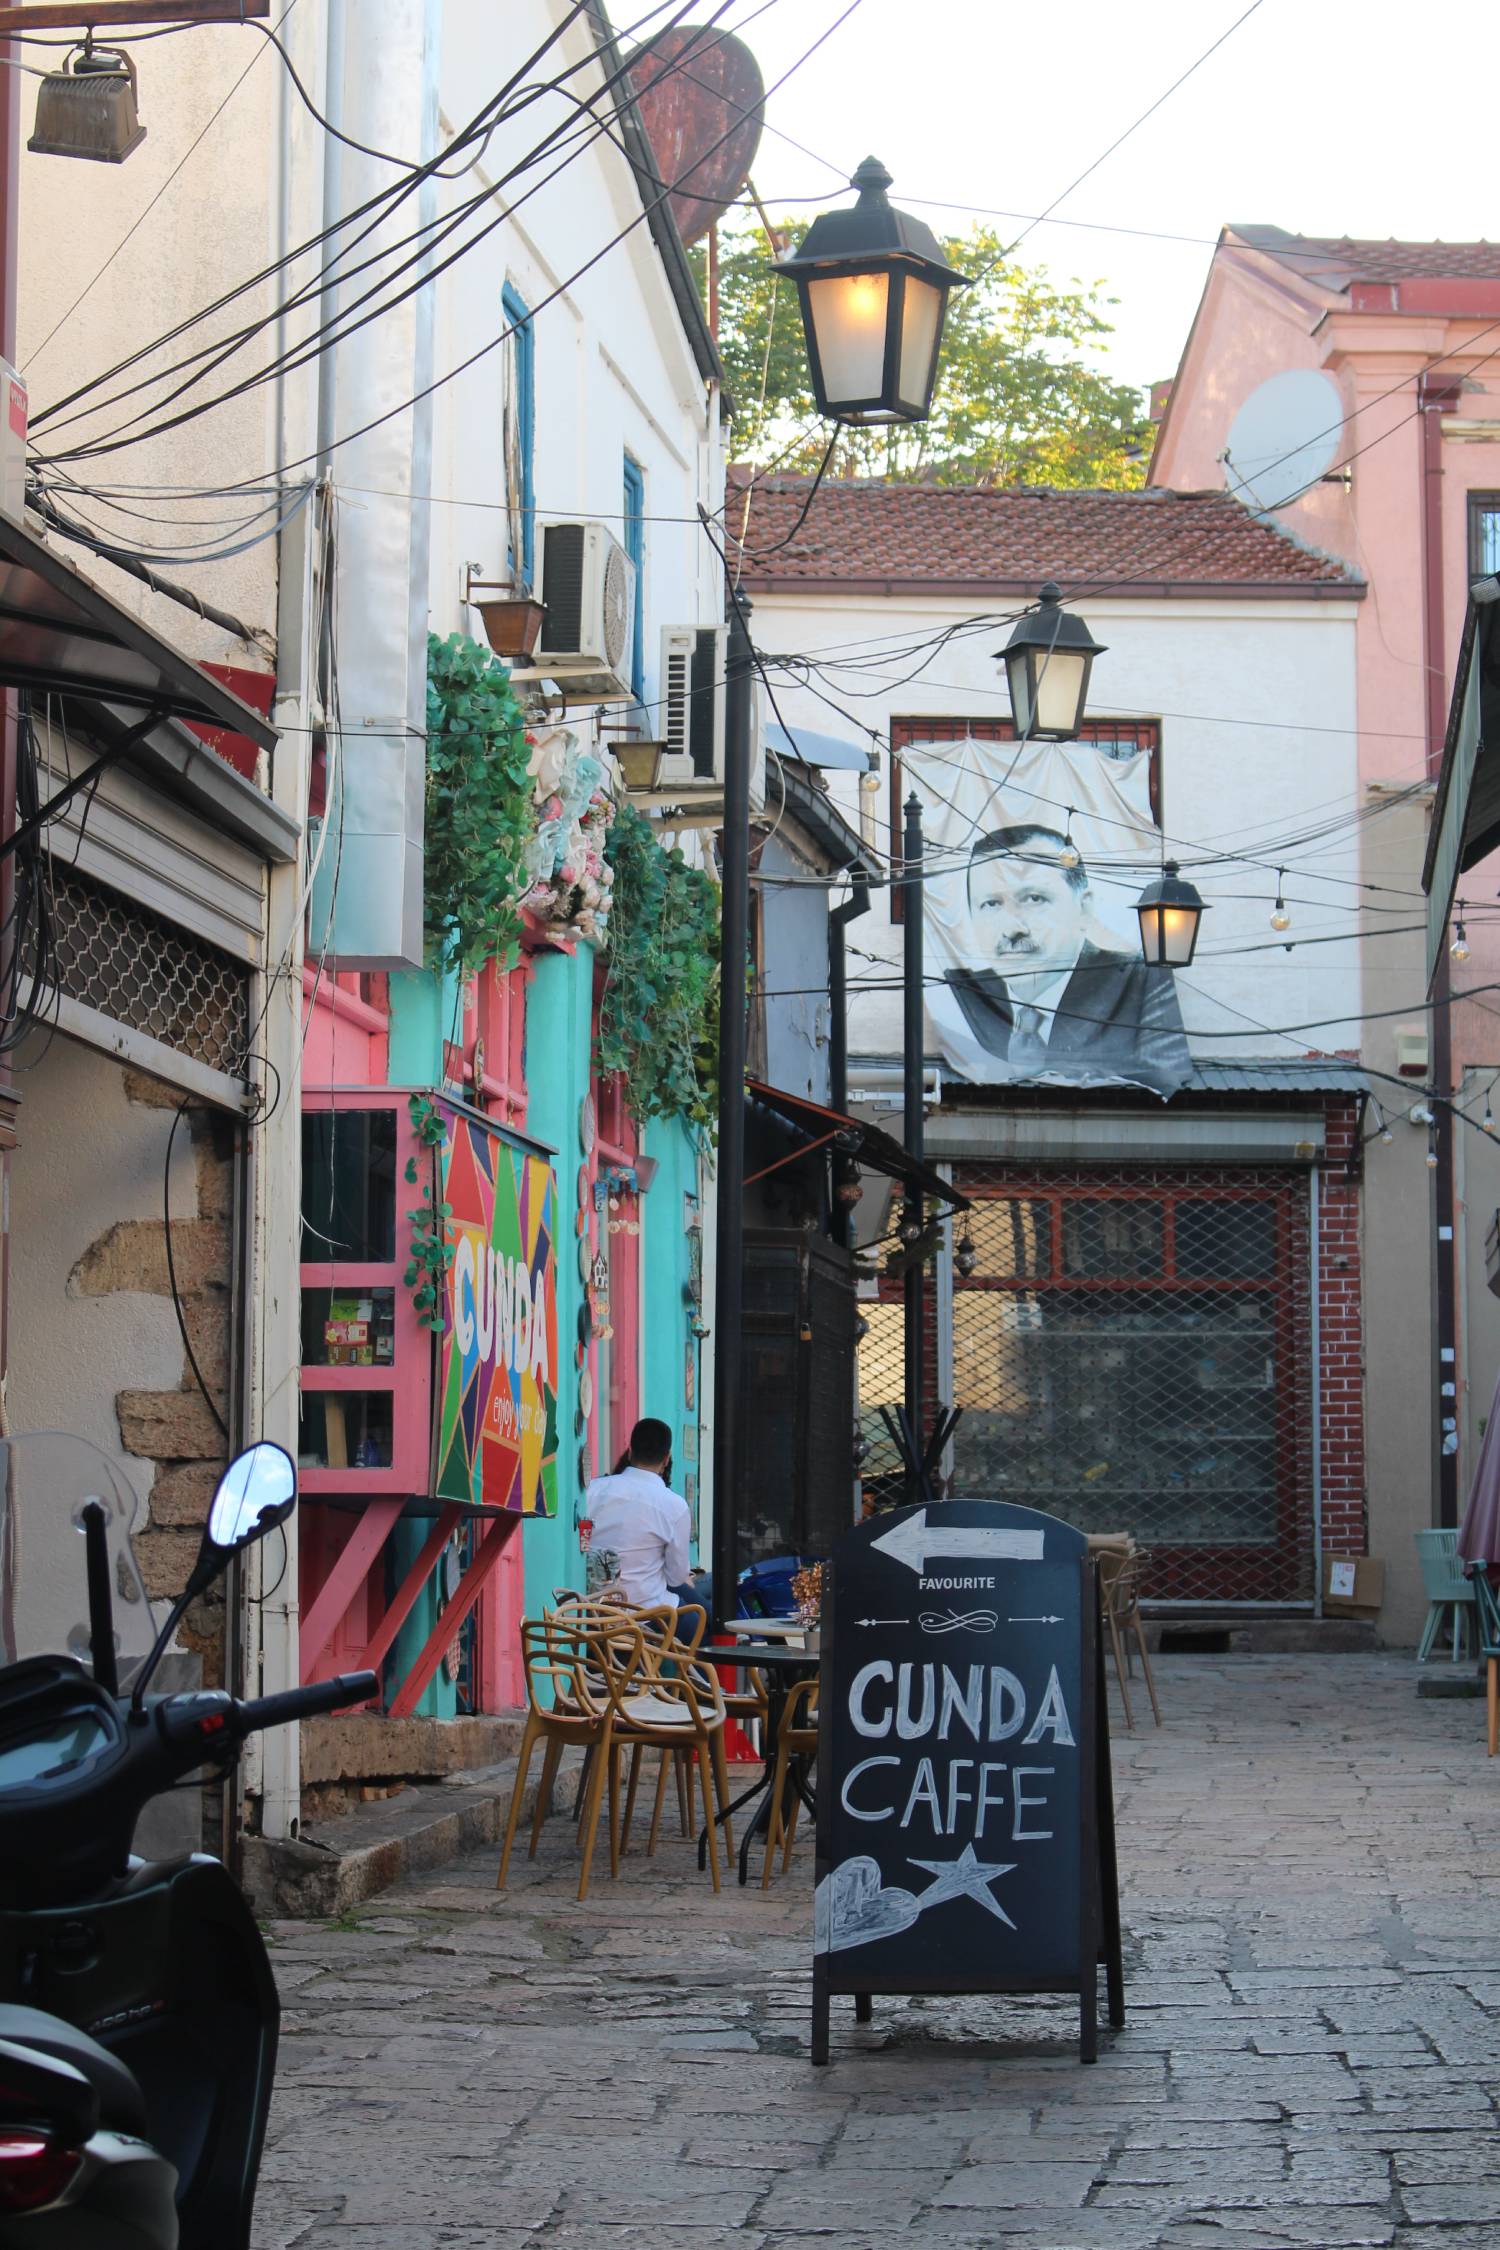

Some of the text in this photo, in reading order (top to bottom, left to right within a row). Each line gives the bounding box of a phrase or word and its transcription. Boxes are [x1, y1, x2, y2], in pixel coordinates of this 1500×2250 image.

[454, 1235, 549, 1383] CUNDA
[918, 1576, 996, 1590] FAVOURITE
[848, 1659, 1077, 1747] CUNDA
[841, 1755, 1055, 1840] CAFFE
